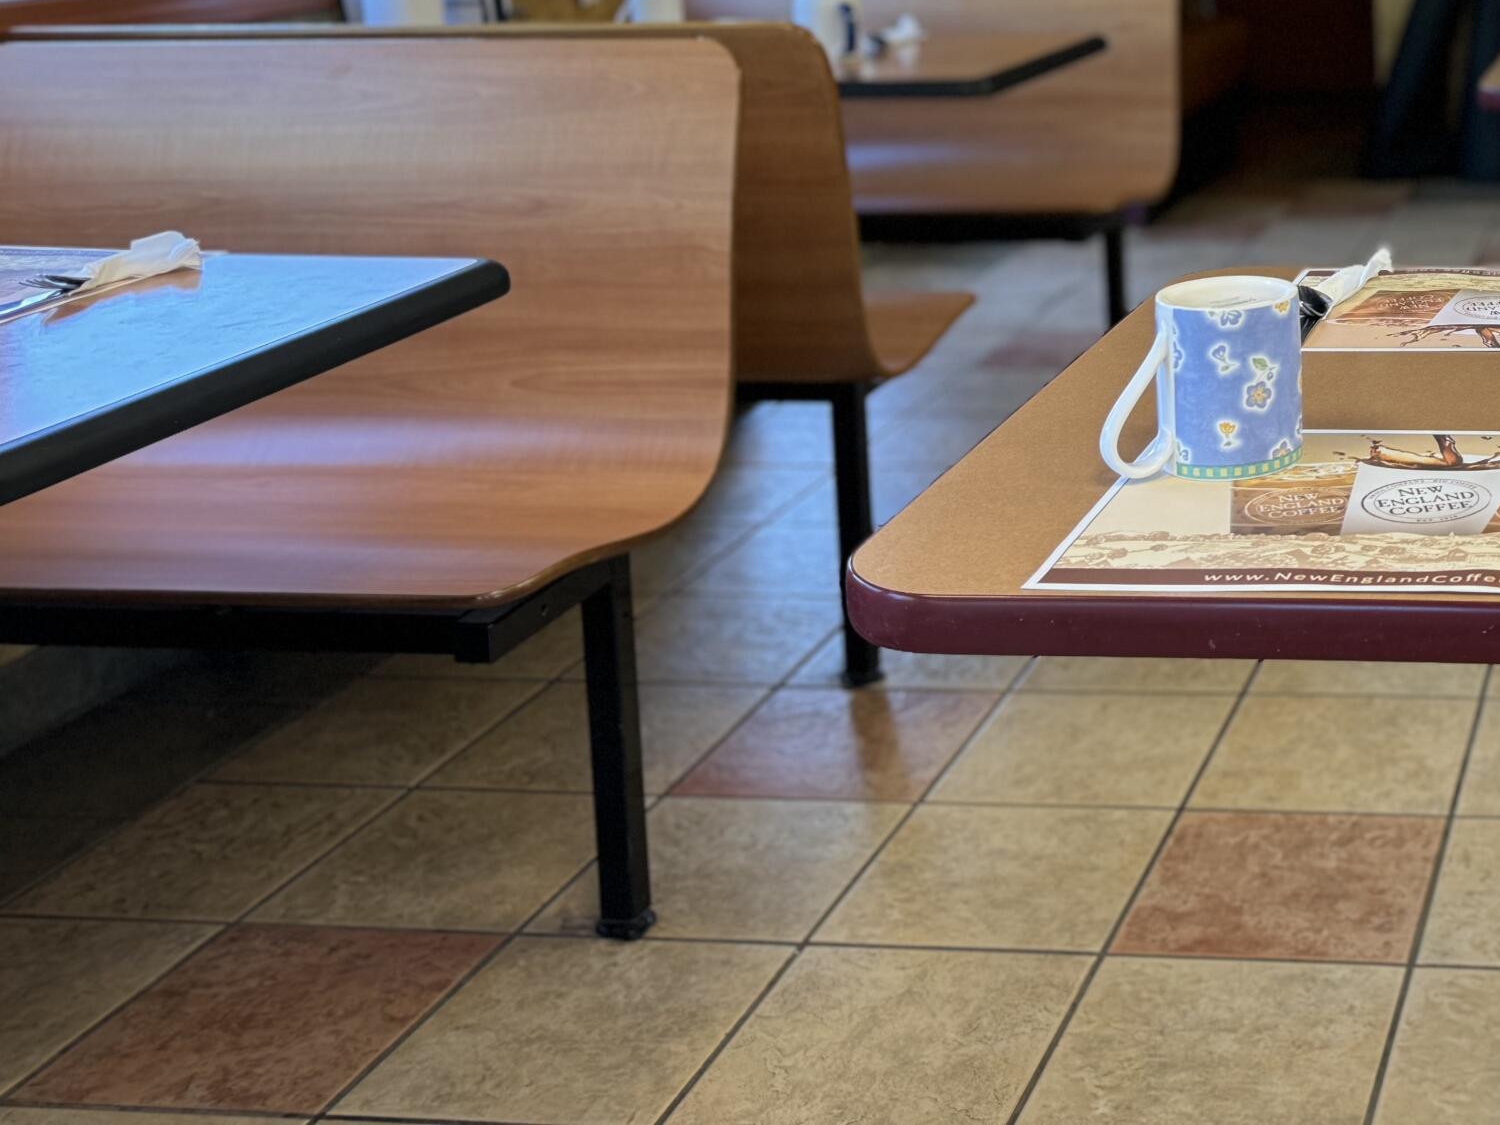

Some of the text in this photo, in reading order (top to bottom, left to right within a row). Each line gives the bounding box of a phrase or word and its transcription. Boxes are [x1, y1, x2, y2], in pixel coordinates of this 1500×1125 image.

[1279, 492, 1319, 503] NEW
[1398, 485, 1443, 497] NEW
[1259, 497, 1345, 513] ENGLAND
[1376, 491, 1475, 508] ENGLAND
[1268, 505, 1342, 519] COFFEE
[1389, 501, 1473, 516] COFFEE
